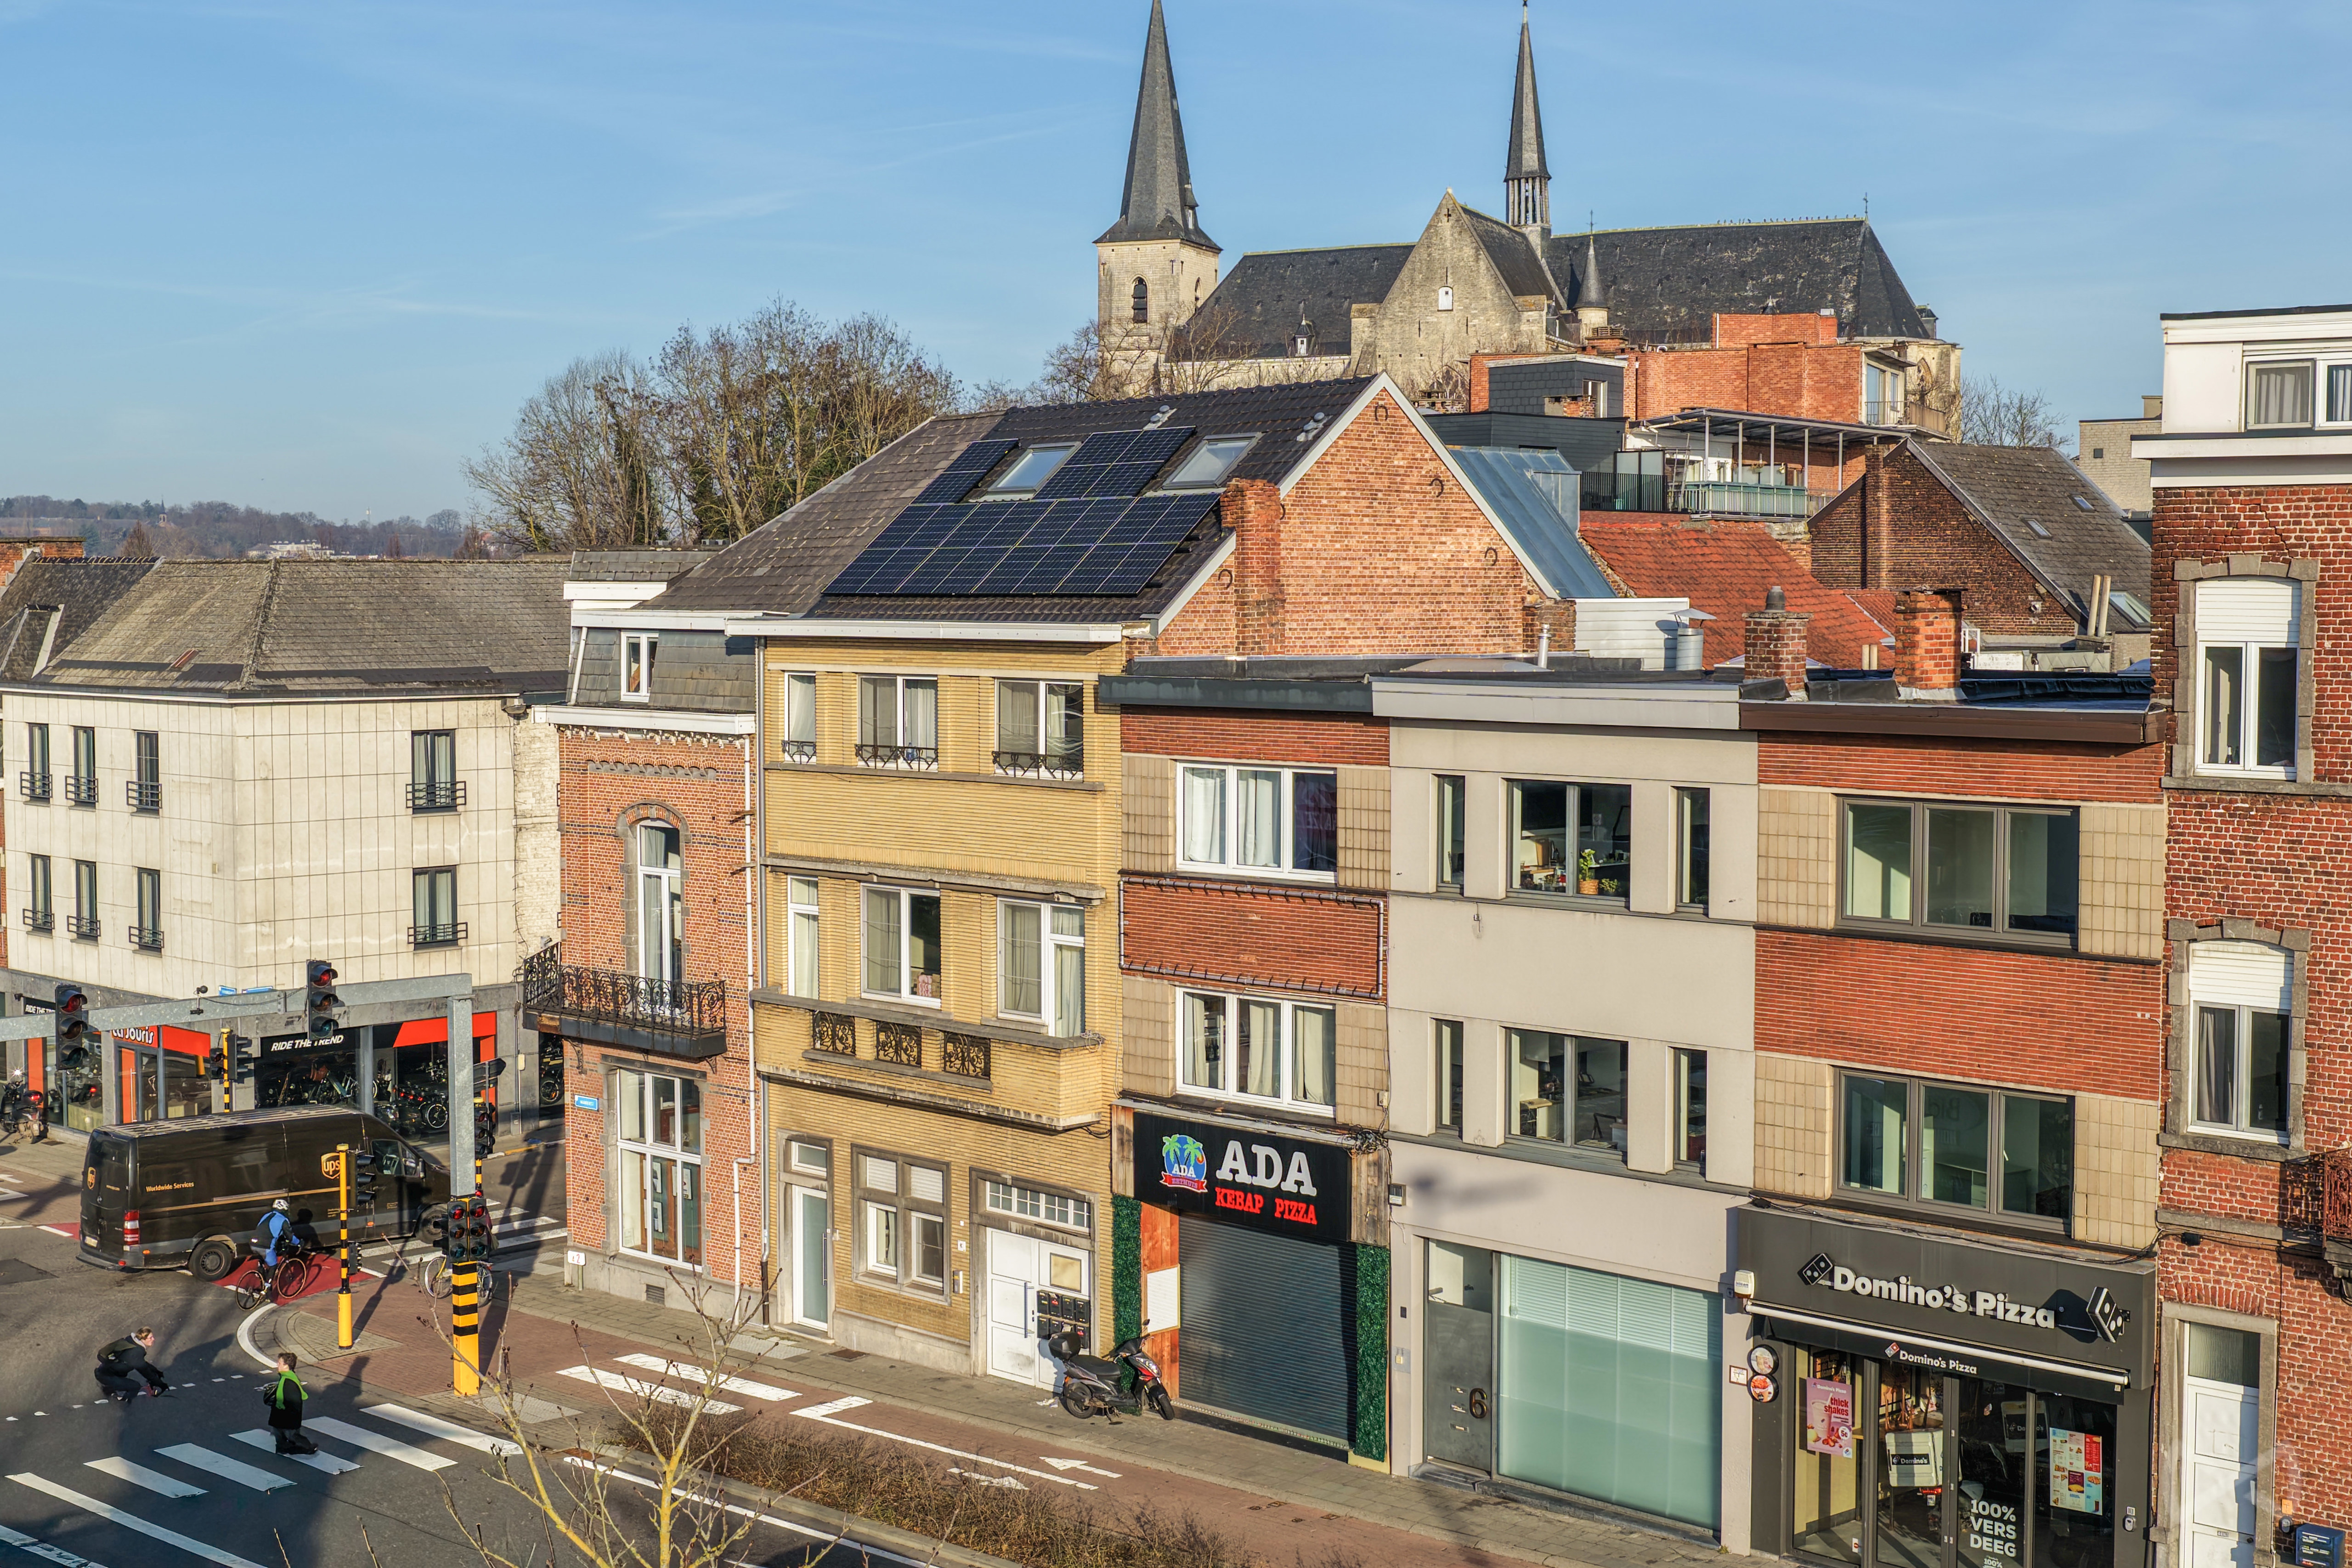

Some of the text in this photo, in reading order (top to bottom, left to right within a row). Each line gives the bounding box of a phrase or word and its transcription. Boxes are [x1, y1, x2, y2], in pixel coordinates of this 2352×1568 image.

[271, 1041, 294, 1051] RIDE
[294, 1039, 312, 1048] THE
[1171, 1164, 1196, 1178] ADA
[1216, 1140, 1317, 1196] ADA
[146, 1184, 172, 1192] Worldwide
[1215, 1187, 1317, 1225] KEBAP PIZZA
[1834, 1266, 2055, 1329] Domino's Pizza
[1900, 1350, 1977, 1374] Domino's Pizza
[1470, 1388, 1487, 1419] 6
[1824, 1405, 1849, 1416] shakes
[1831, 1397, 1849, 1408] thick
[1971, 1499, 2016, 1522] 100%
[1970, 1516, 2017, 1540] VERS
[1970, 1533, 2017, 1557] DEEG
[1984, 1558, 2003, 1568] 100%
